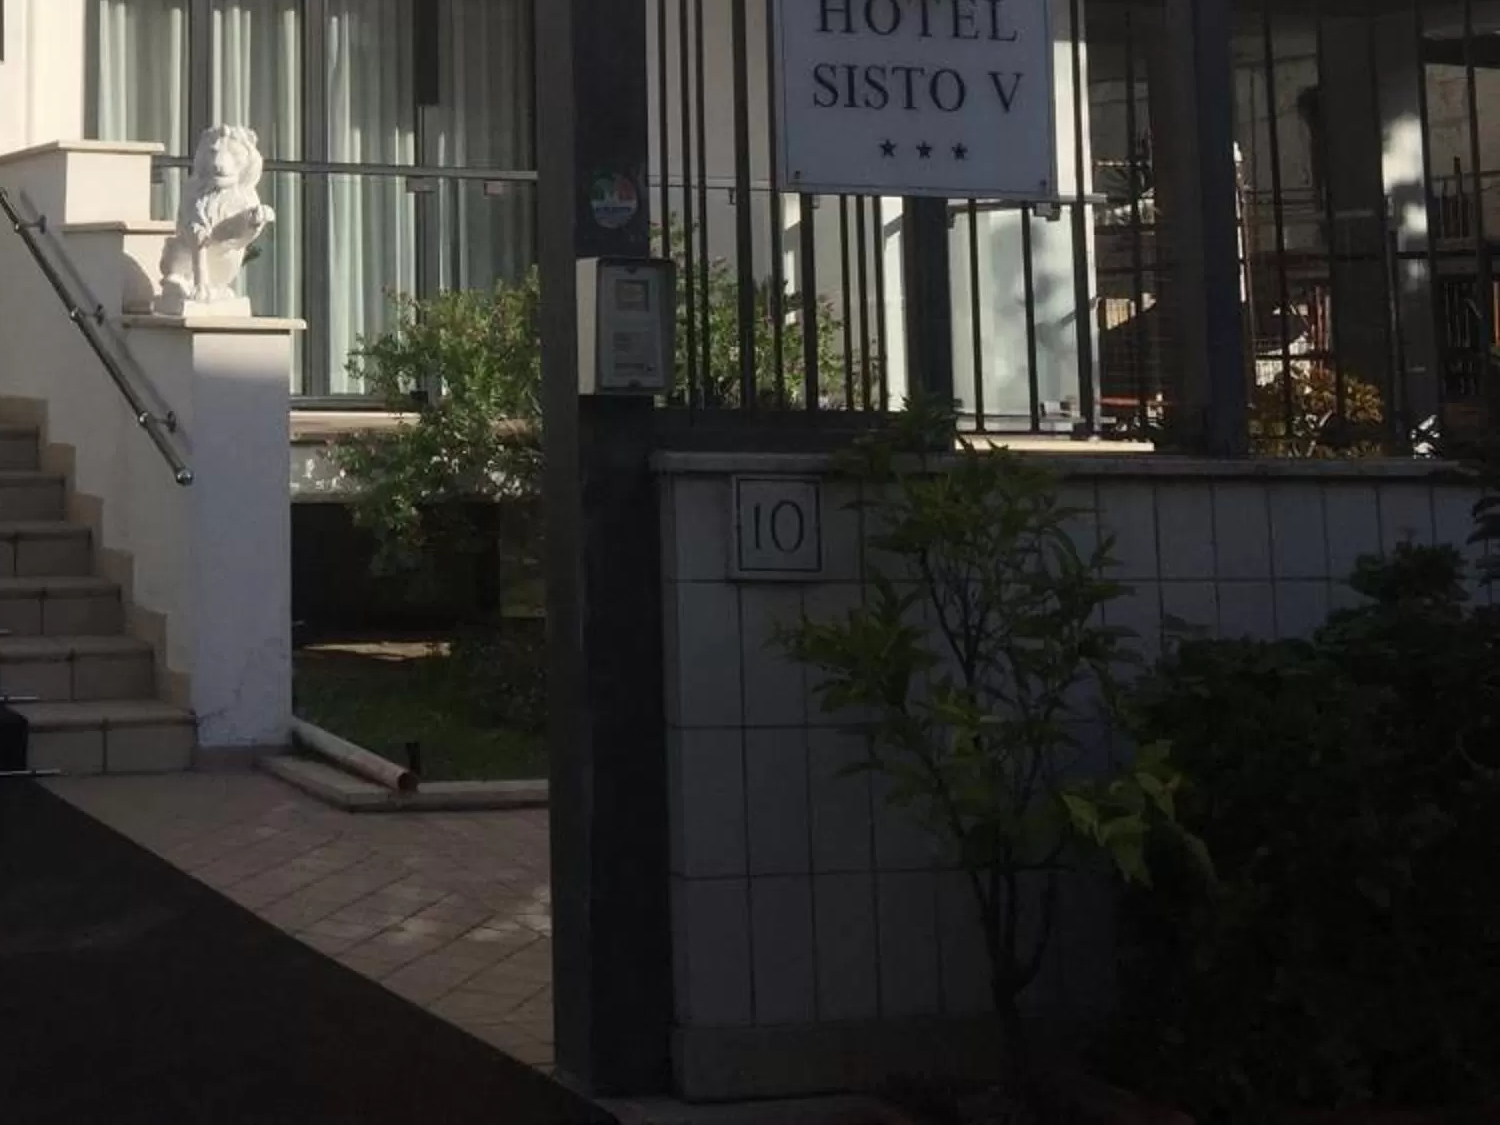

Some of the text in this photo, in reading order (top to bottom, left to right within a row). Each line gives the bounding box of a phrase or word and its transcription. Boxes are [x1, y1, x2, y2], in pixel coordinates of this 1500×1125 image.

[812, 64, 1023, 113] SISTO V
[753, 500, 805, 553] 10
